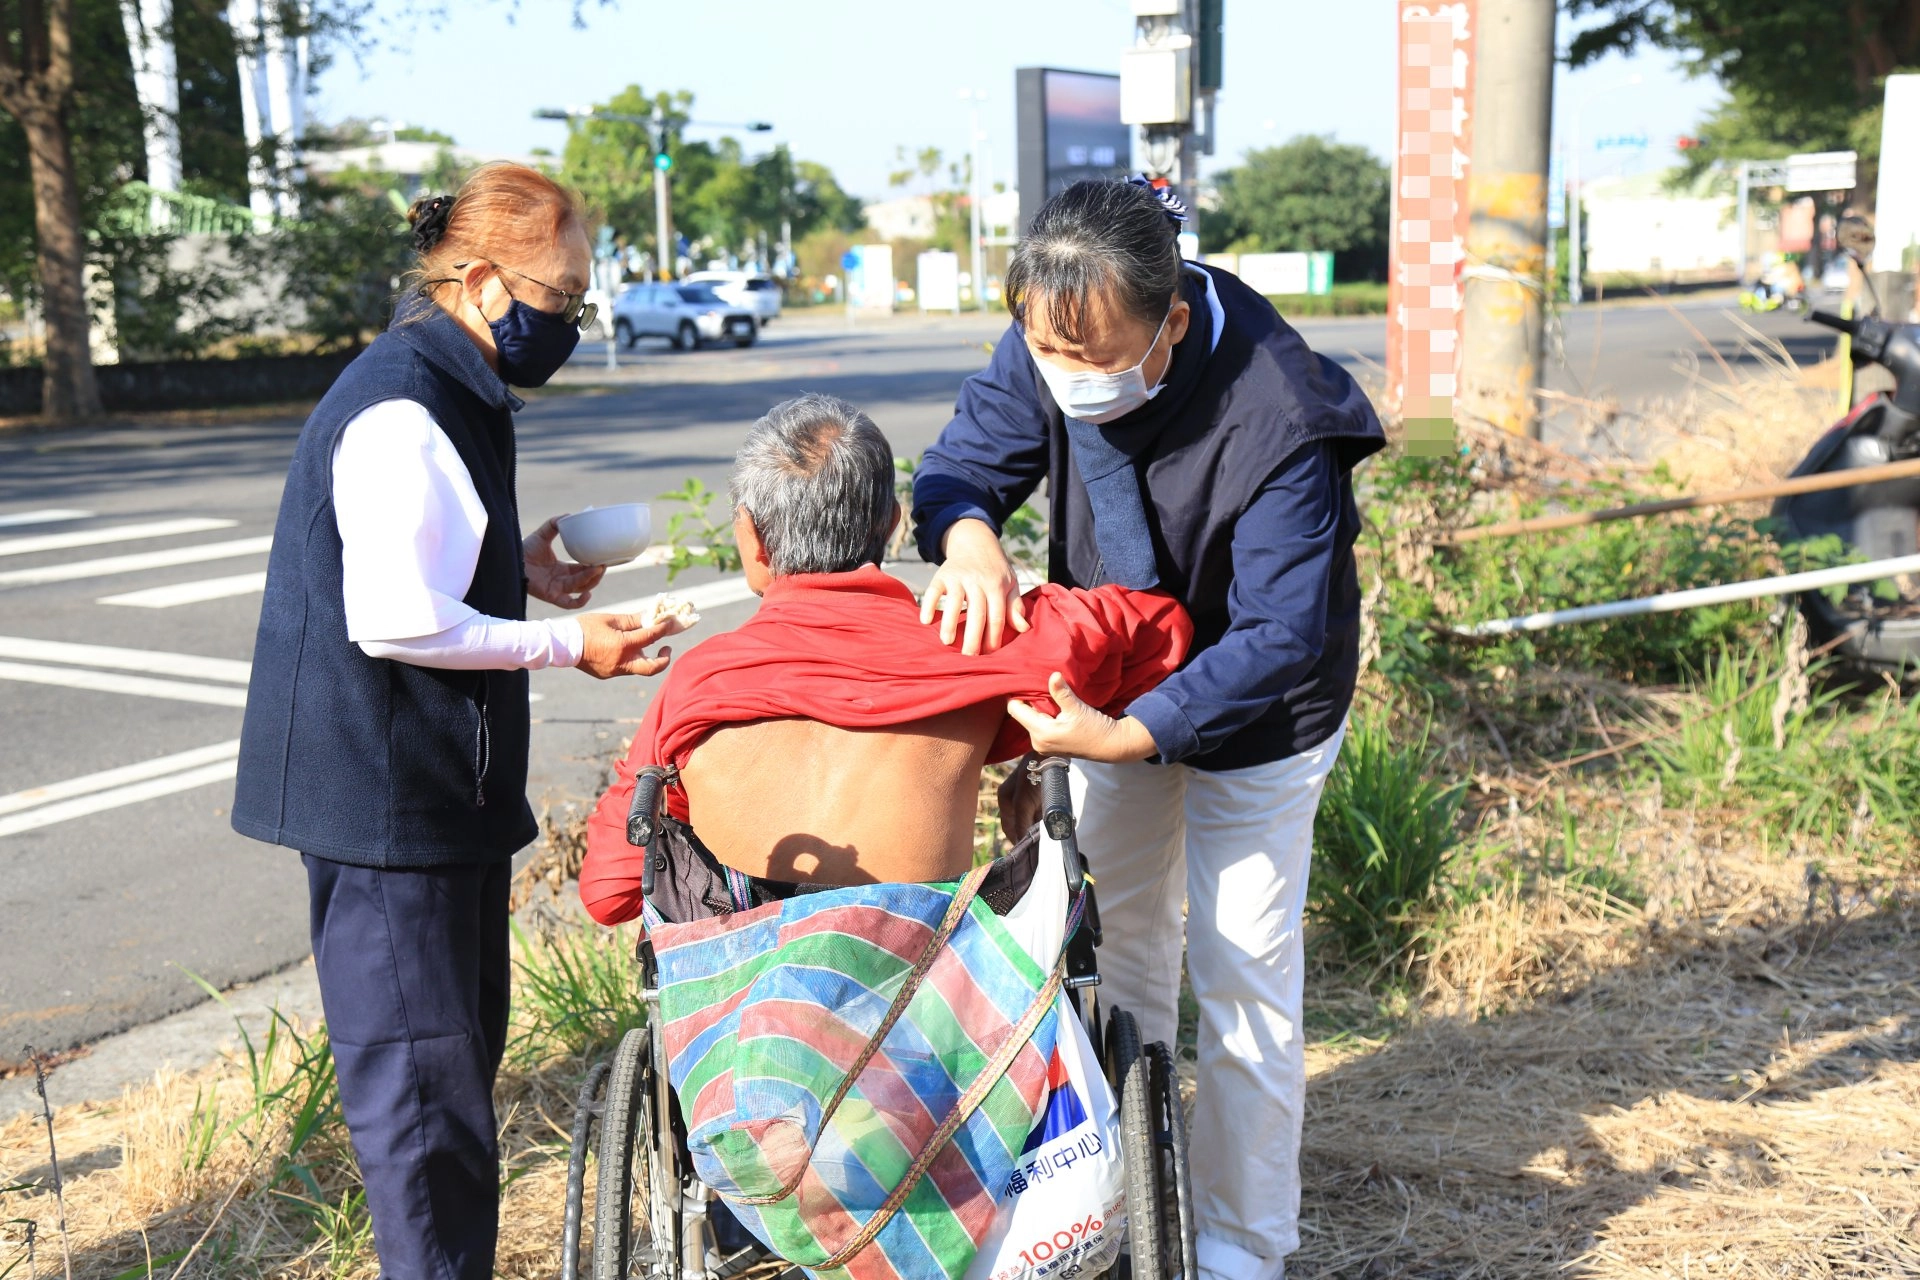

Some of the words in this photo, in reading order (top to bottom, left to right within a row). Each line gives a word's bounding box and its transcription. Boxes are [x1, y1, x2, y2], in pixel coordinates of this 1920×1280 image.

[1006, 1133, 1102, 1197] 福利中心
[1018, 1214, 1104, 1267] 100%
